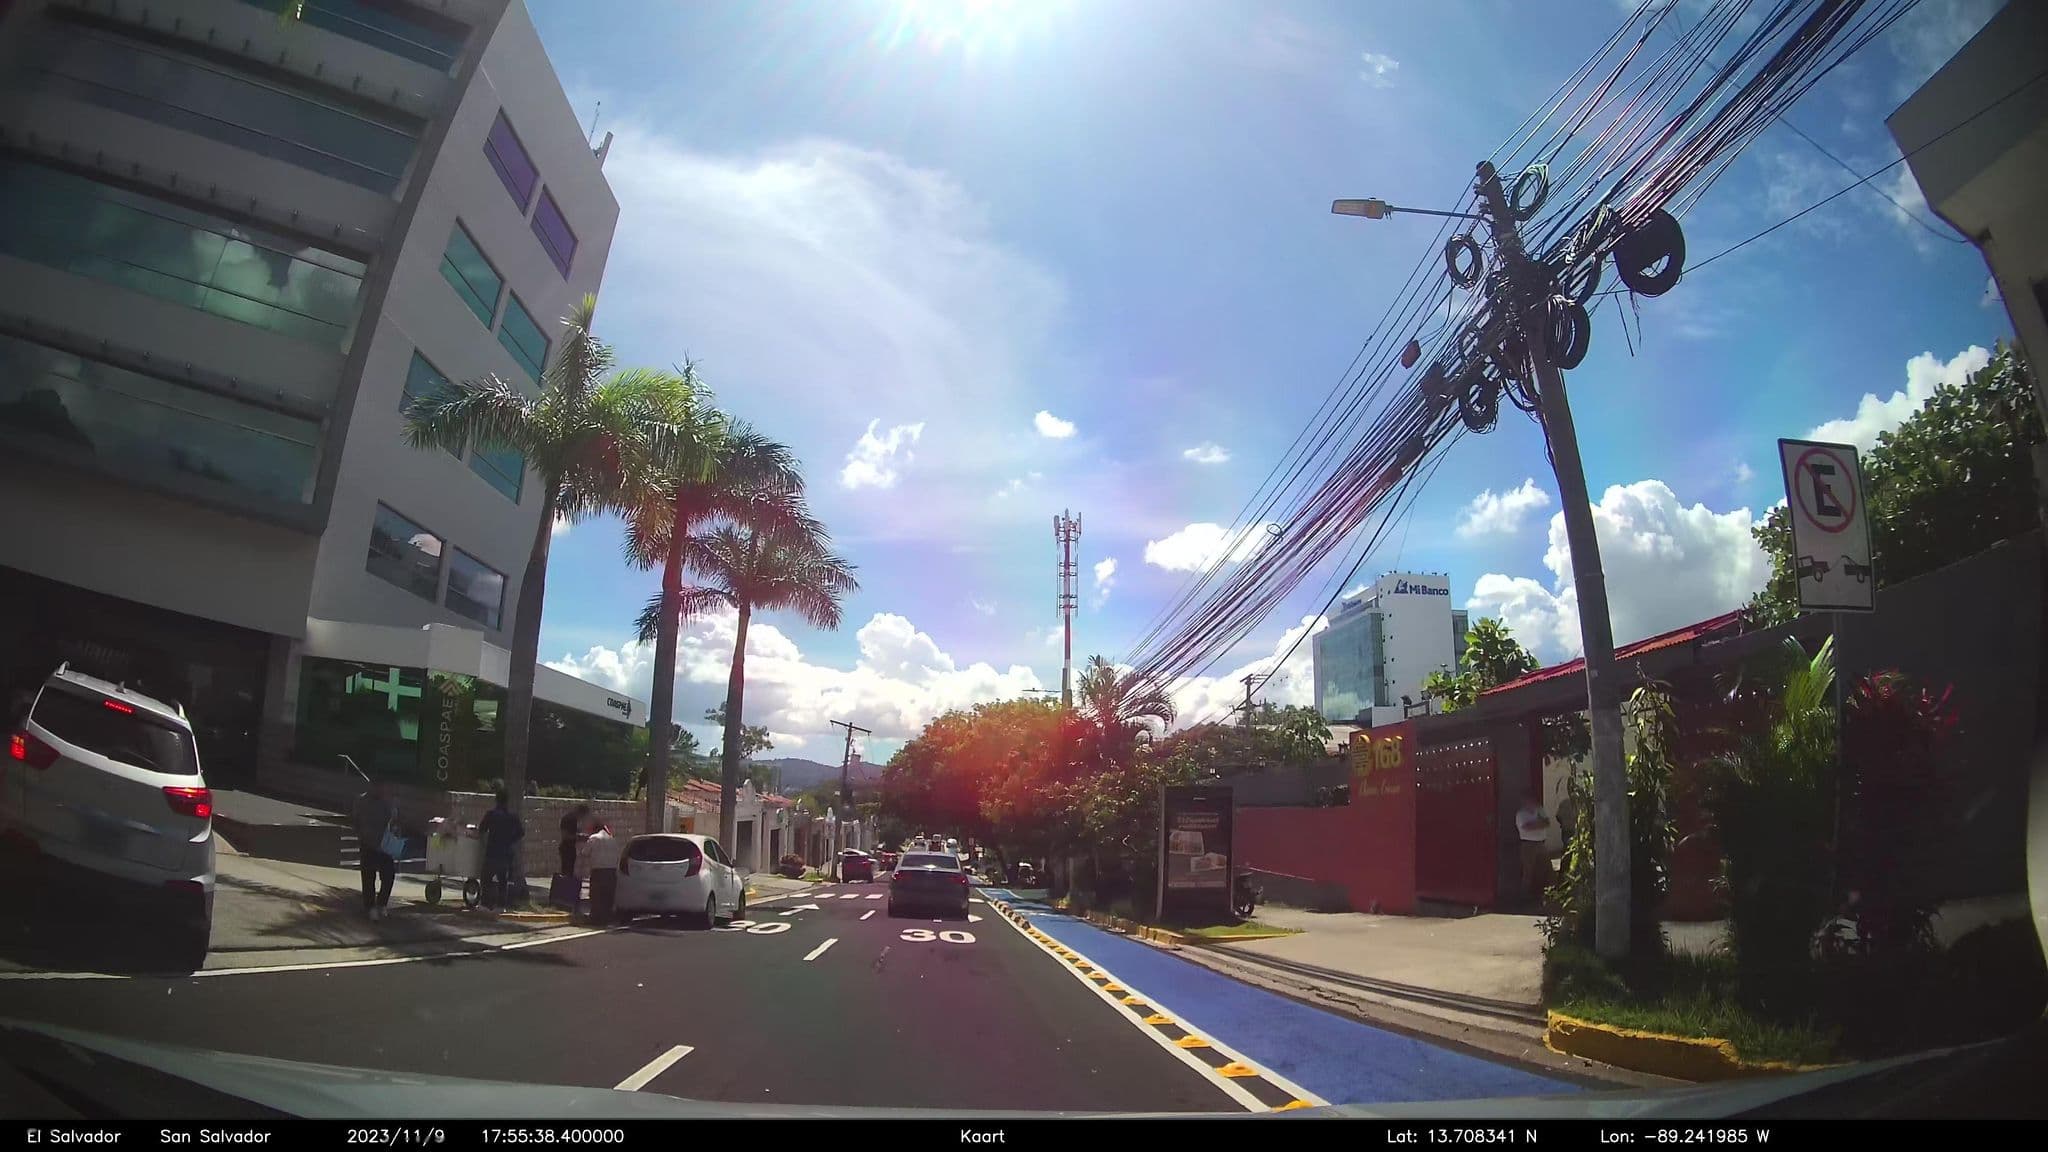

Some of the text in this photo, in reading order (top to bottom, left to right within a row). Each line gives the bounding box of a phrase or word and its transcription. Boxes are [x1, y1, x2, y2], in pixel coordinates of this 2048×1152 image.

[1812, 464, 1842, 517] E
[1409, 584, 1449, 596] Mi Banco
[437, 698, 453, 781] COASPAE
[1374, 736, 1403, 768] 168
[900, 929, 976, 943] 30
